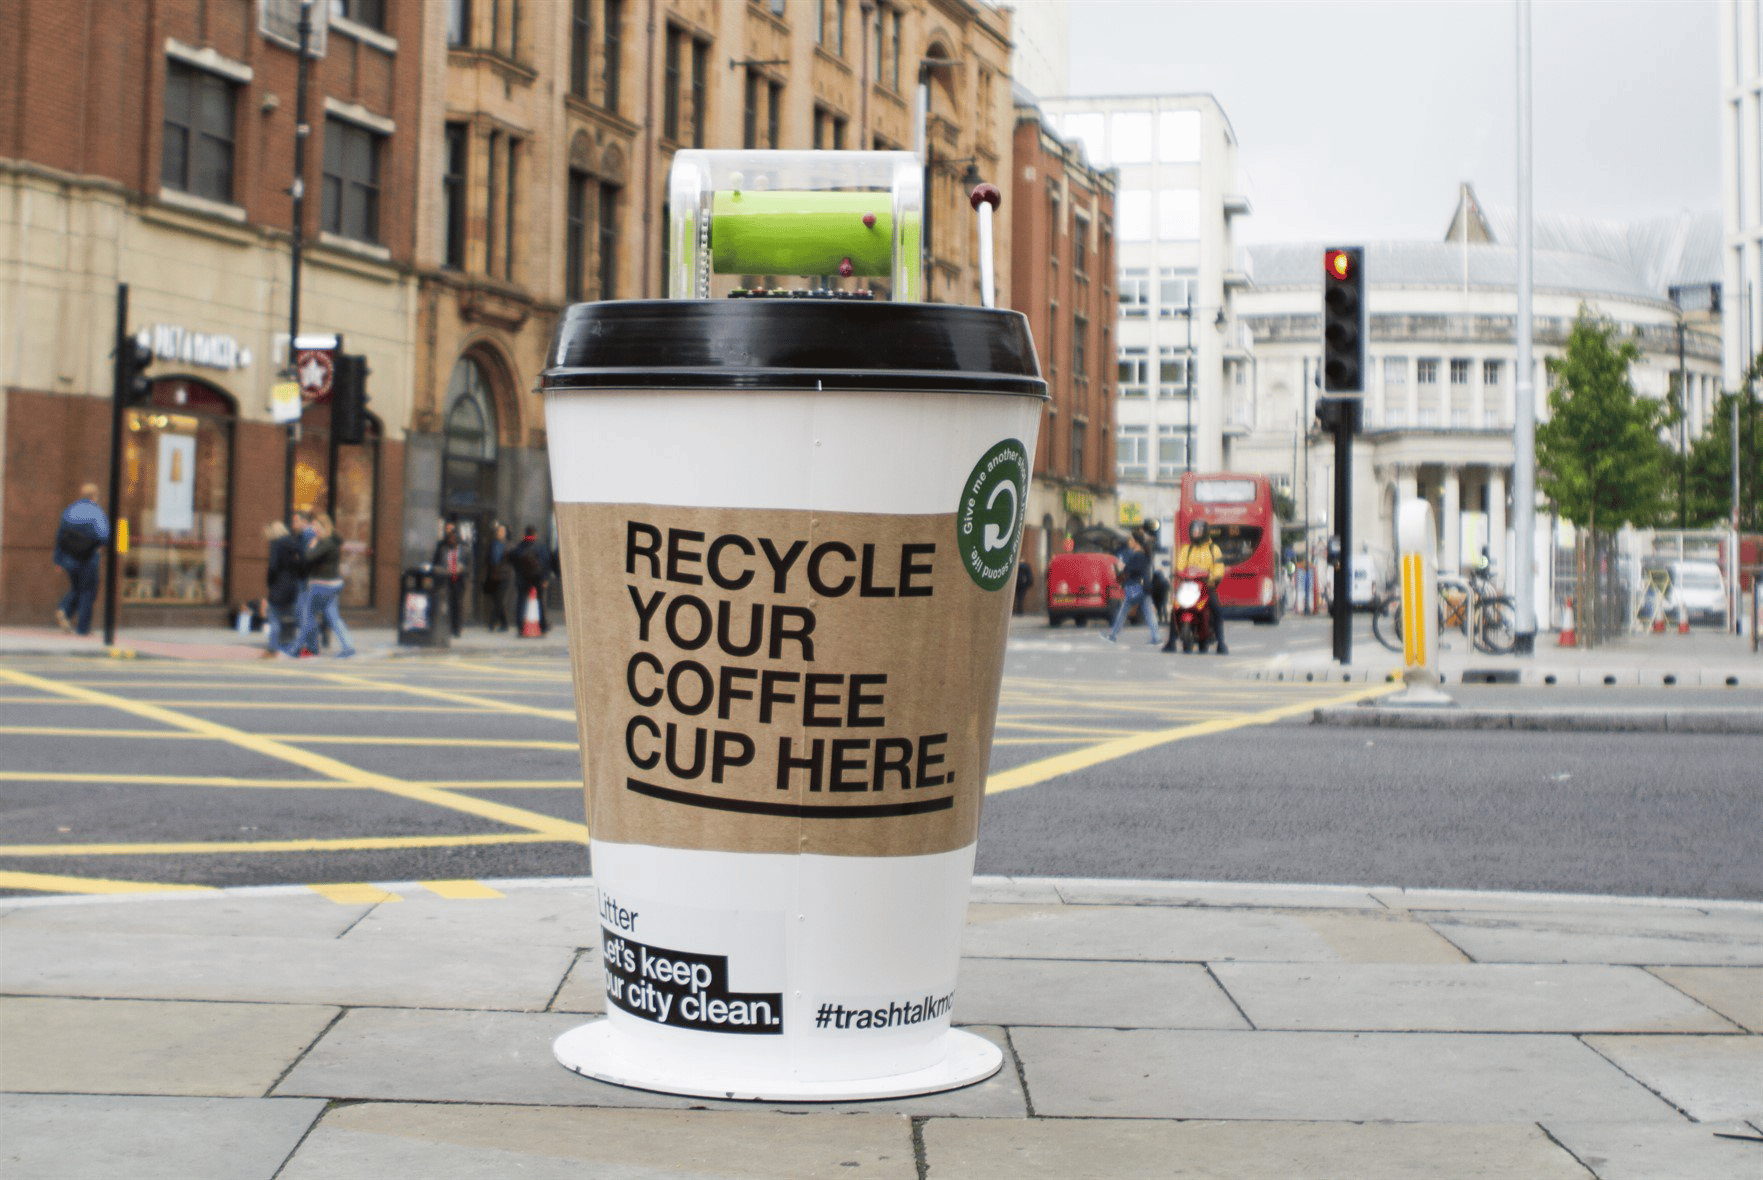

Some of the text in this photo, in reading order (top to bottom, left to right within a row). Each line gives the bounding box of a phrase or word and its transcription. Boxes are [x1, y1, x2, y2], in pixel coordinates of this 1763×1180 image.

[972, 471, 987, 494] me
[987, 448, 1019, 473] another
[963, 498, 976, 535] Give
[626, 520, 937, 598] RECYCLE
[970, 545, 984, 574] life.
[627, 584, 817, 662] YOUR
[626, 651, 888, 728] COFFEE
[625, 715, 956, 793] CUP HERE.
[641, 946, 713, 994] keep
[628, 979, 674, 1023] city
[680, 990, 780, 1026] clean.
